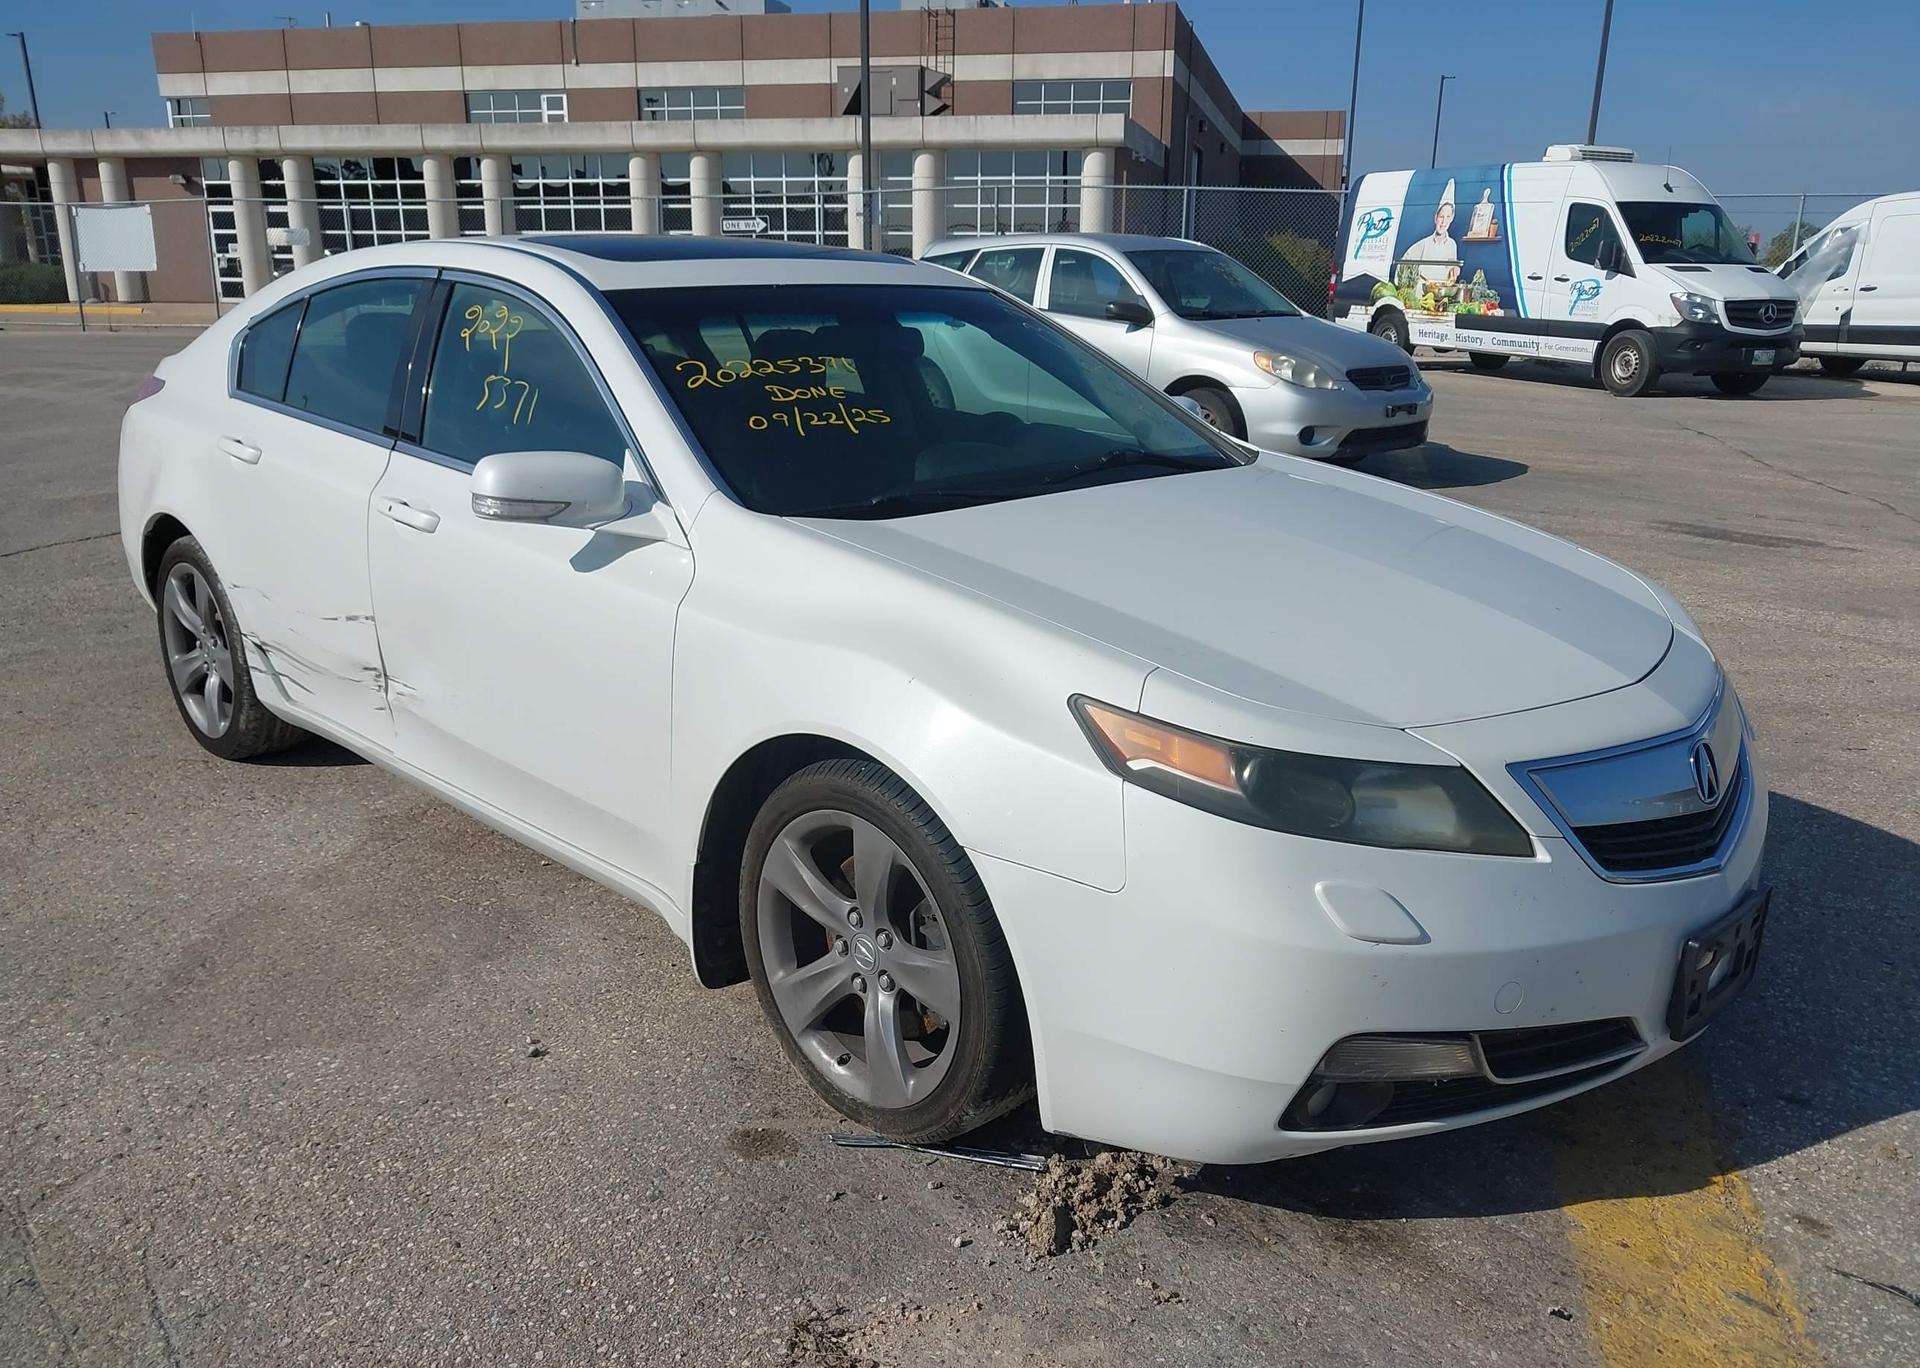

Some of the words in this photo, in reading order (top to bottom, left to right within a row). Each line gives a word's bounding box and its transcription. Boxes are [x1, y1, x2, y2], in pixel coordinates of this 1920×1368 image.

[725, 222, 741, 230] ONE
[744, 222, 760, 230] WAY
[1455, 333, 1486, 346] History.
[1491, 337, 1542, 351] Community.
[764, 385, 846, 402] DONE
[749, 402, 891, 436] 09/22/25
